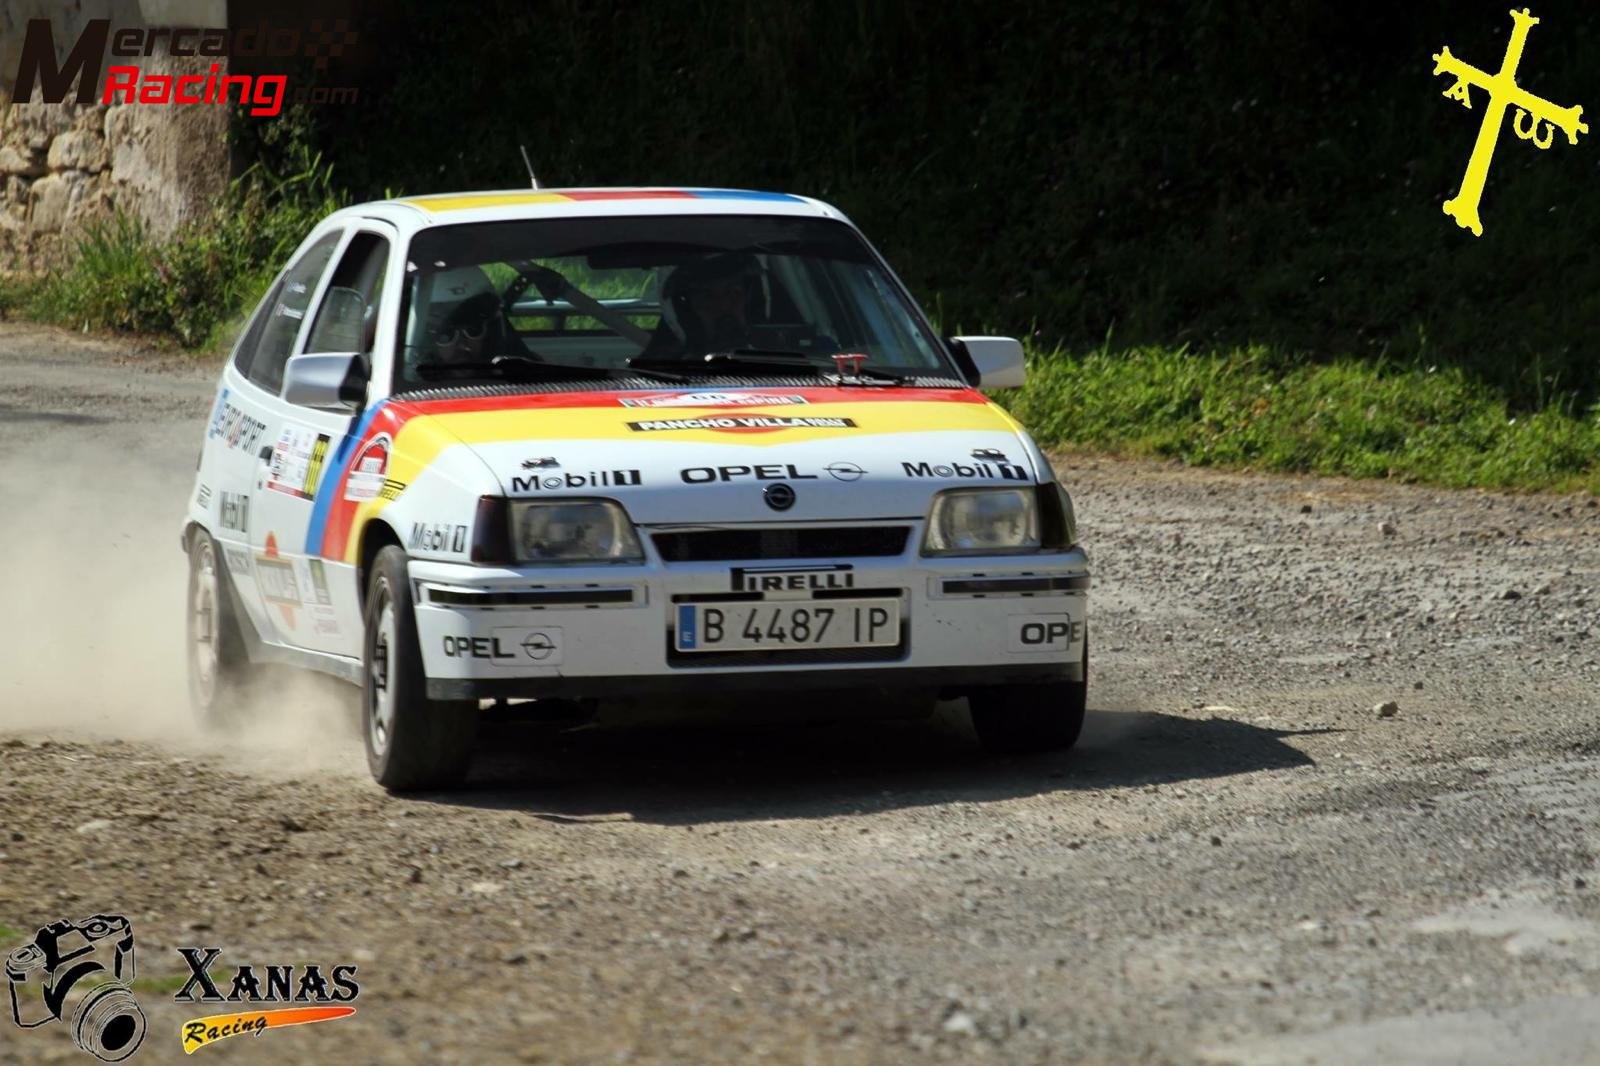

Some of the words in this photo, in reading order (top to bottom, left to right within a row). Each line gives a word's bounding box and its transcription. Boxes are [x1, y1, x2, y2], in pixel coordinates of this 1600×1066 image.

[639, 418, 736, 431] PANCHO
[736, 417, 805, 429] VILLA
[511, 470, 608, 492] Mobil
[681, 463, 818, 484] OPEL
[901, 462, 994, 478] Mobil
[730, 564, 855, 591] PIRELLI
[703, 608, 726, 644] B
[742, 608, 835, 644] 4487
[854, 606, 889, 642] IP
[443, 635, 516, 659] OPEL
